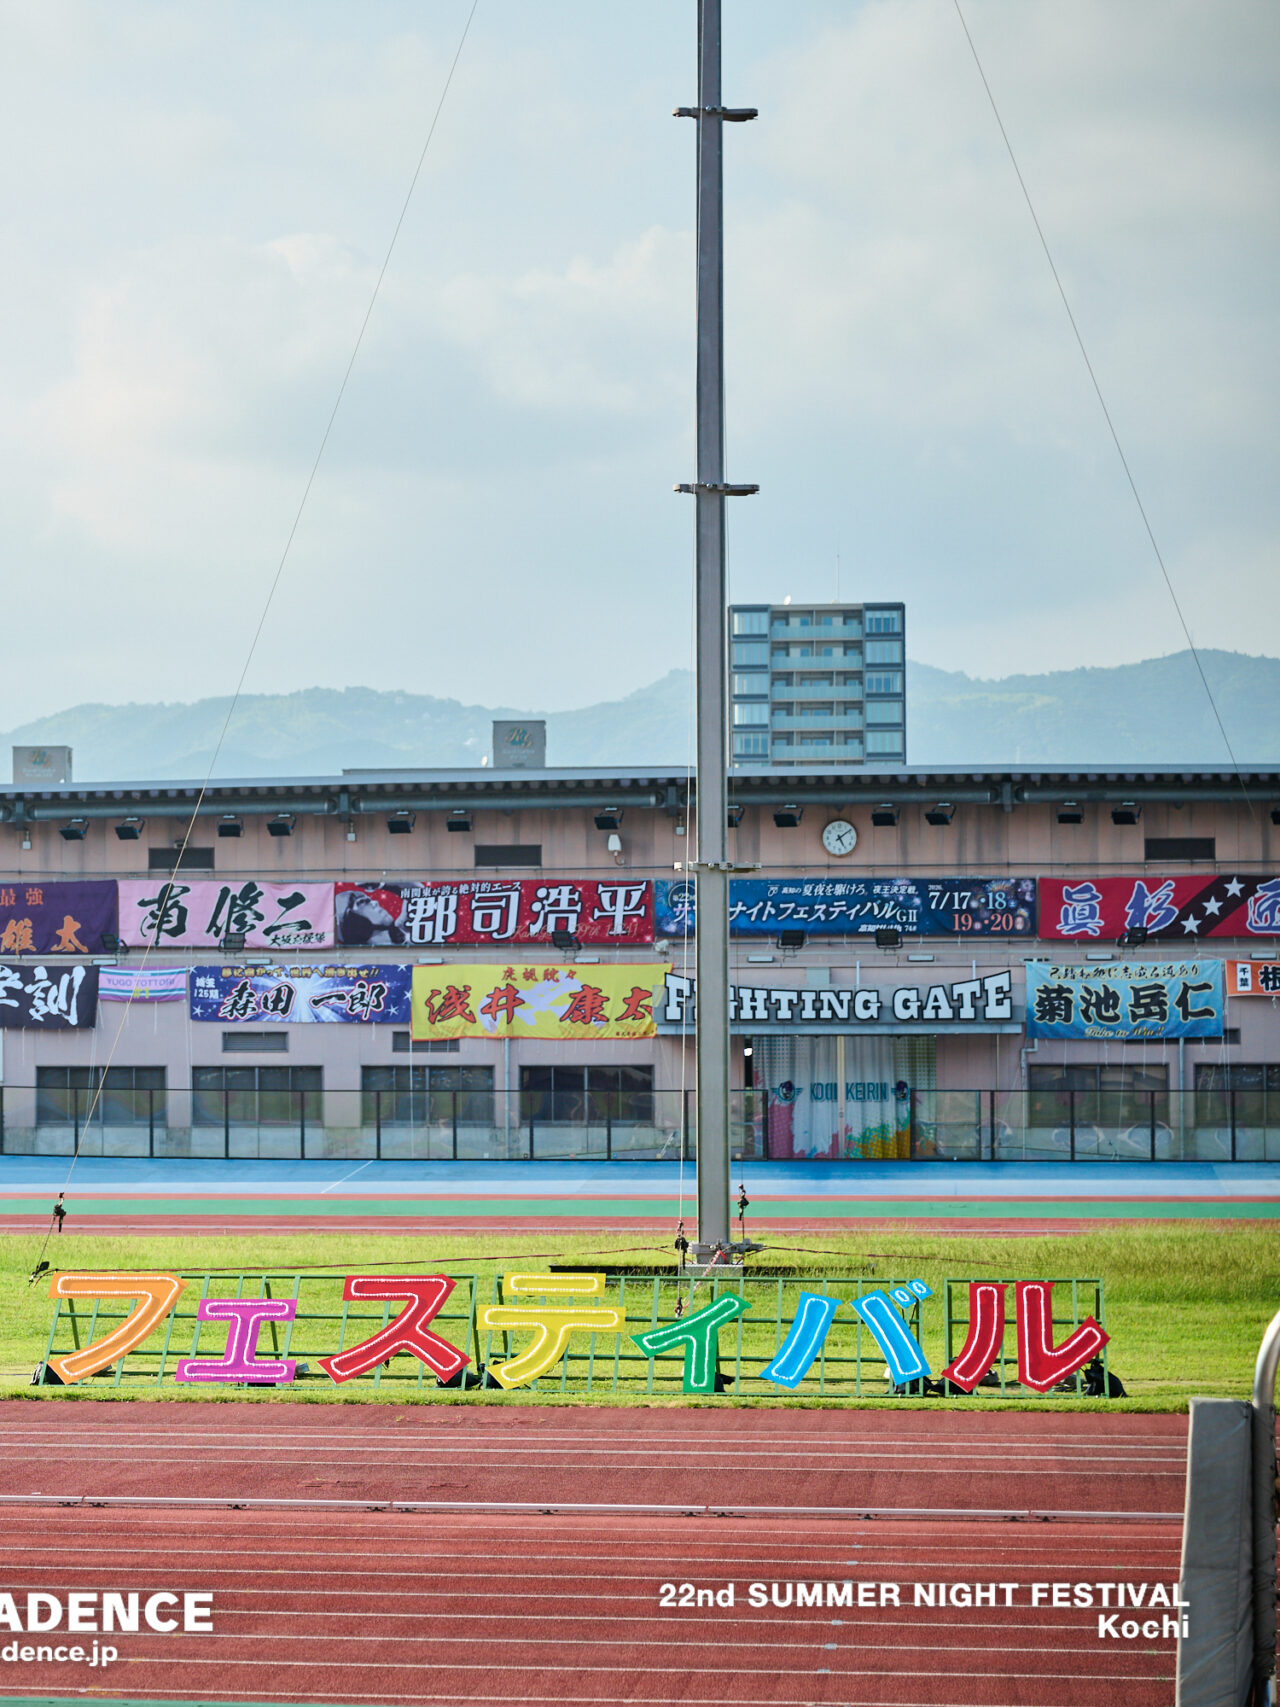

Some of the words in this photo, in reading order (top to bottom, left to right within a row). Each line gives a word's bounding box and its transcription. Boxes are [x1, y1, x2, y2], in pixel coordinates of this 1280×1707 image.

[137, 881, 313, 946] 南修二
[406, 881, 647, 943] 郡司浩平
[928, 891, 972, 910] 7/17
[953, 913, 973, 931] 19
[194, 988, 219, 999] 125期
[218, 979, 388, 1020] 森田一郎
[425, 983, 653, 1024] 浅井康太
[665, 973, 882, 1021] FHTING
[893, 970, 1012, 1020] GATE
[1034, 982, 1216, 1024] 菊池岳仁
[846, 1081, 889, 1101] KEIRIN
[48, 1271, 1111, 1394] フェスティバル
